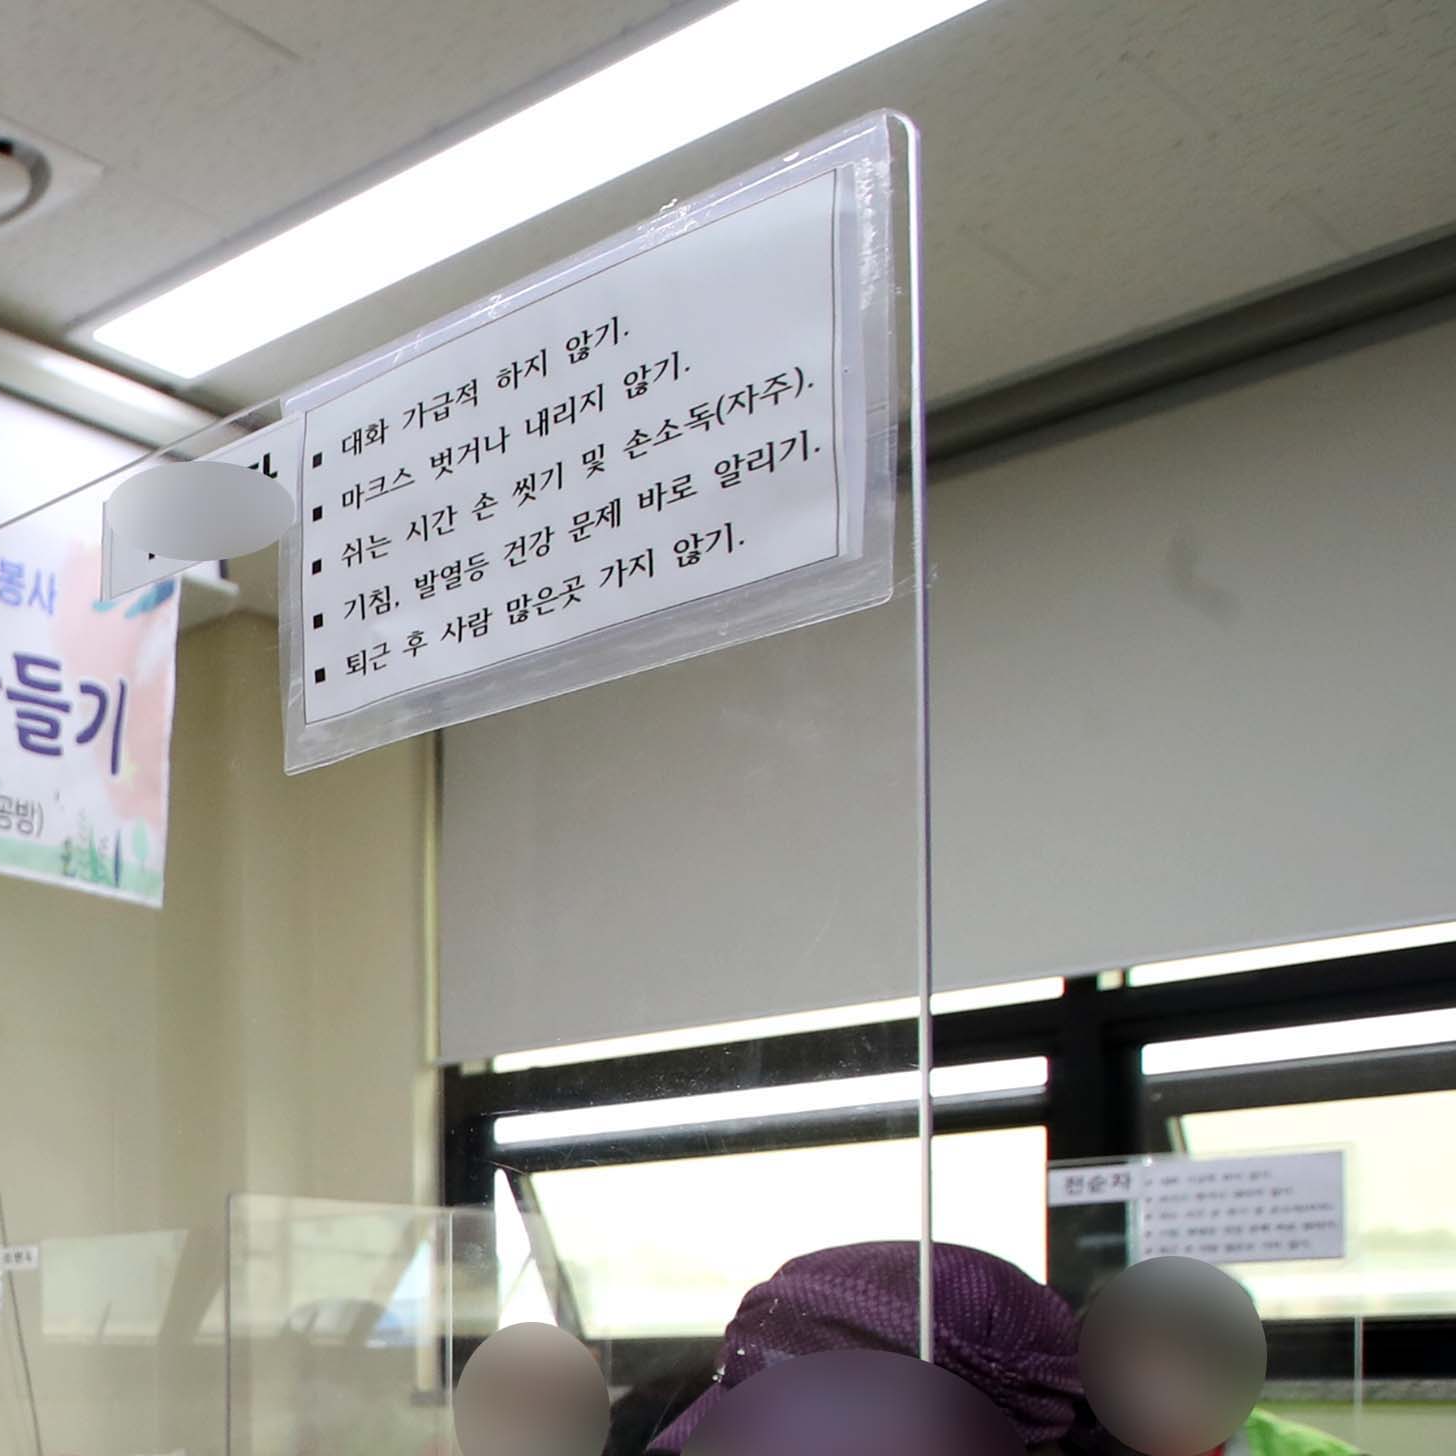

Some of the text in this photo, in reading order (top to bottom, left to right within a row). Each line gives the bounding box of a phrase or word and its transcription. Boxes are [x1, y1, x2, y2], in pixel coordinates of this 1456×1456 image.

[341, 315, 629, 456] 대화 가급적 하지 않기.
[341, 350, 691, 510] 마크스 벗거나 내리지 않기.
[341, 366, 815, 568] 쉬는 시간 손 씻기 및 손소독(자주).
[413, 551, 491, 600] 발열등
[503, 525, 556, 567] 건강
[568, 497, 622, 543] 문제
[637, 473, 698, 512] 바로
[713, 429, 821, 489] 알리기.
[345, 522, 745, 677] 퇴근 후 사람 많은곳 가지 않기.
